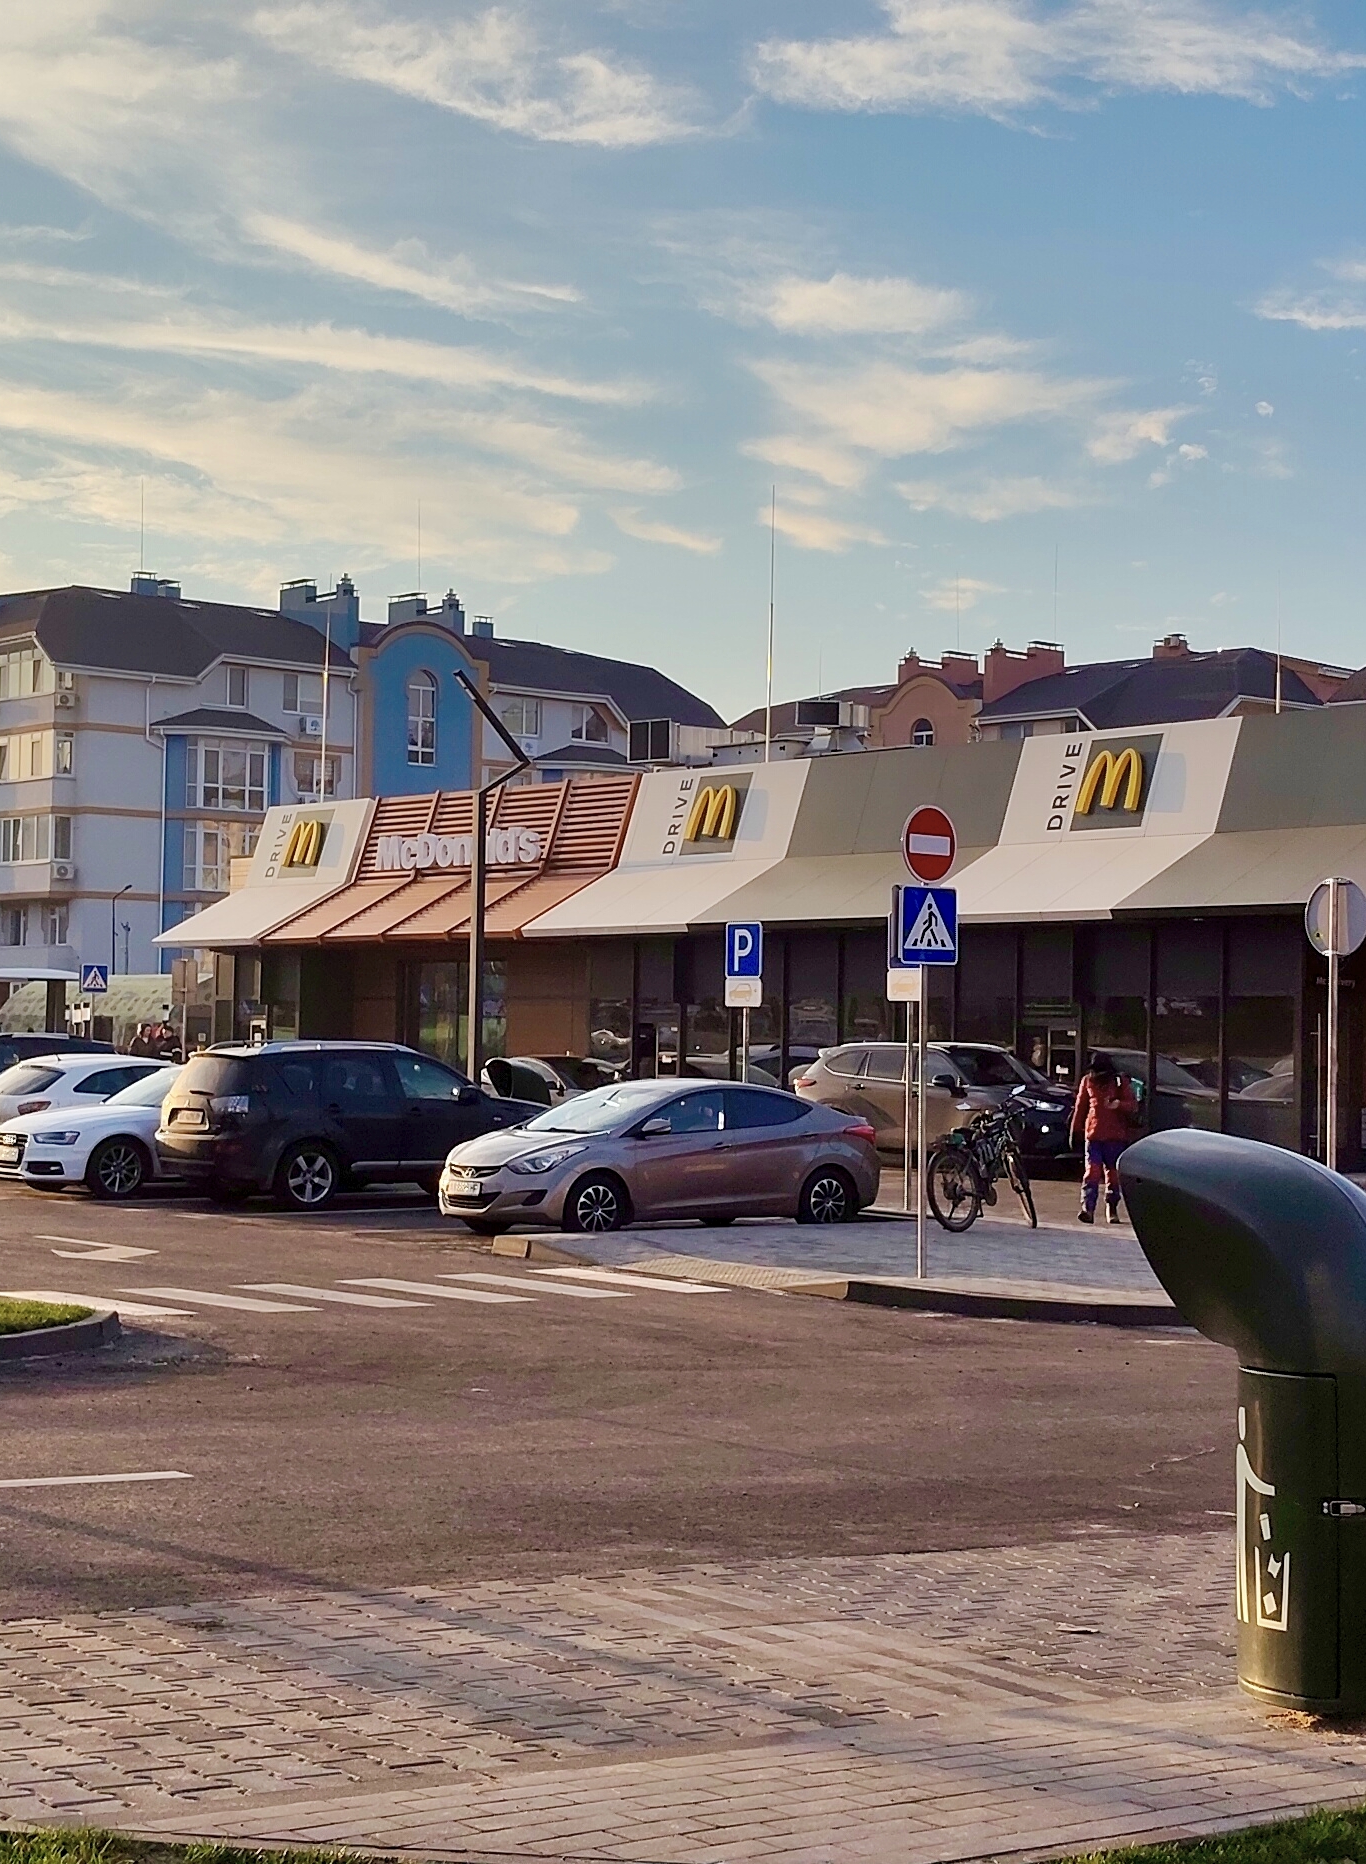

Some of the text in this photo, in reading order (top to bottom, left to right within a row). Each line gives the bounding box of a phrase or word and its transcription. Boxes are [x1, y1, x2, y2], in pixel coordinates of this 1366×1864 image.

[662, 777, 694, 855] DRIVE
[1047, 741, 1083, 831] DRIVE
[264, 812, 293, 878] DRIVE
[375, 826, 542, 871] McDonld's
[734, 928, 753, 972] P
